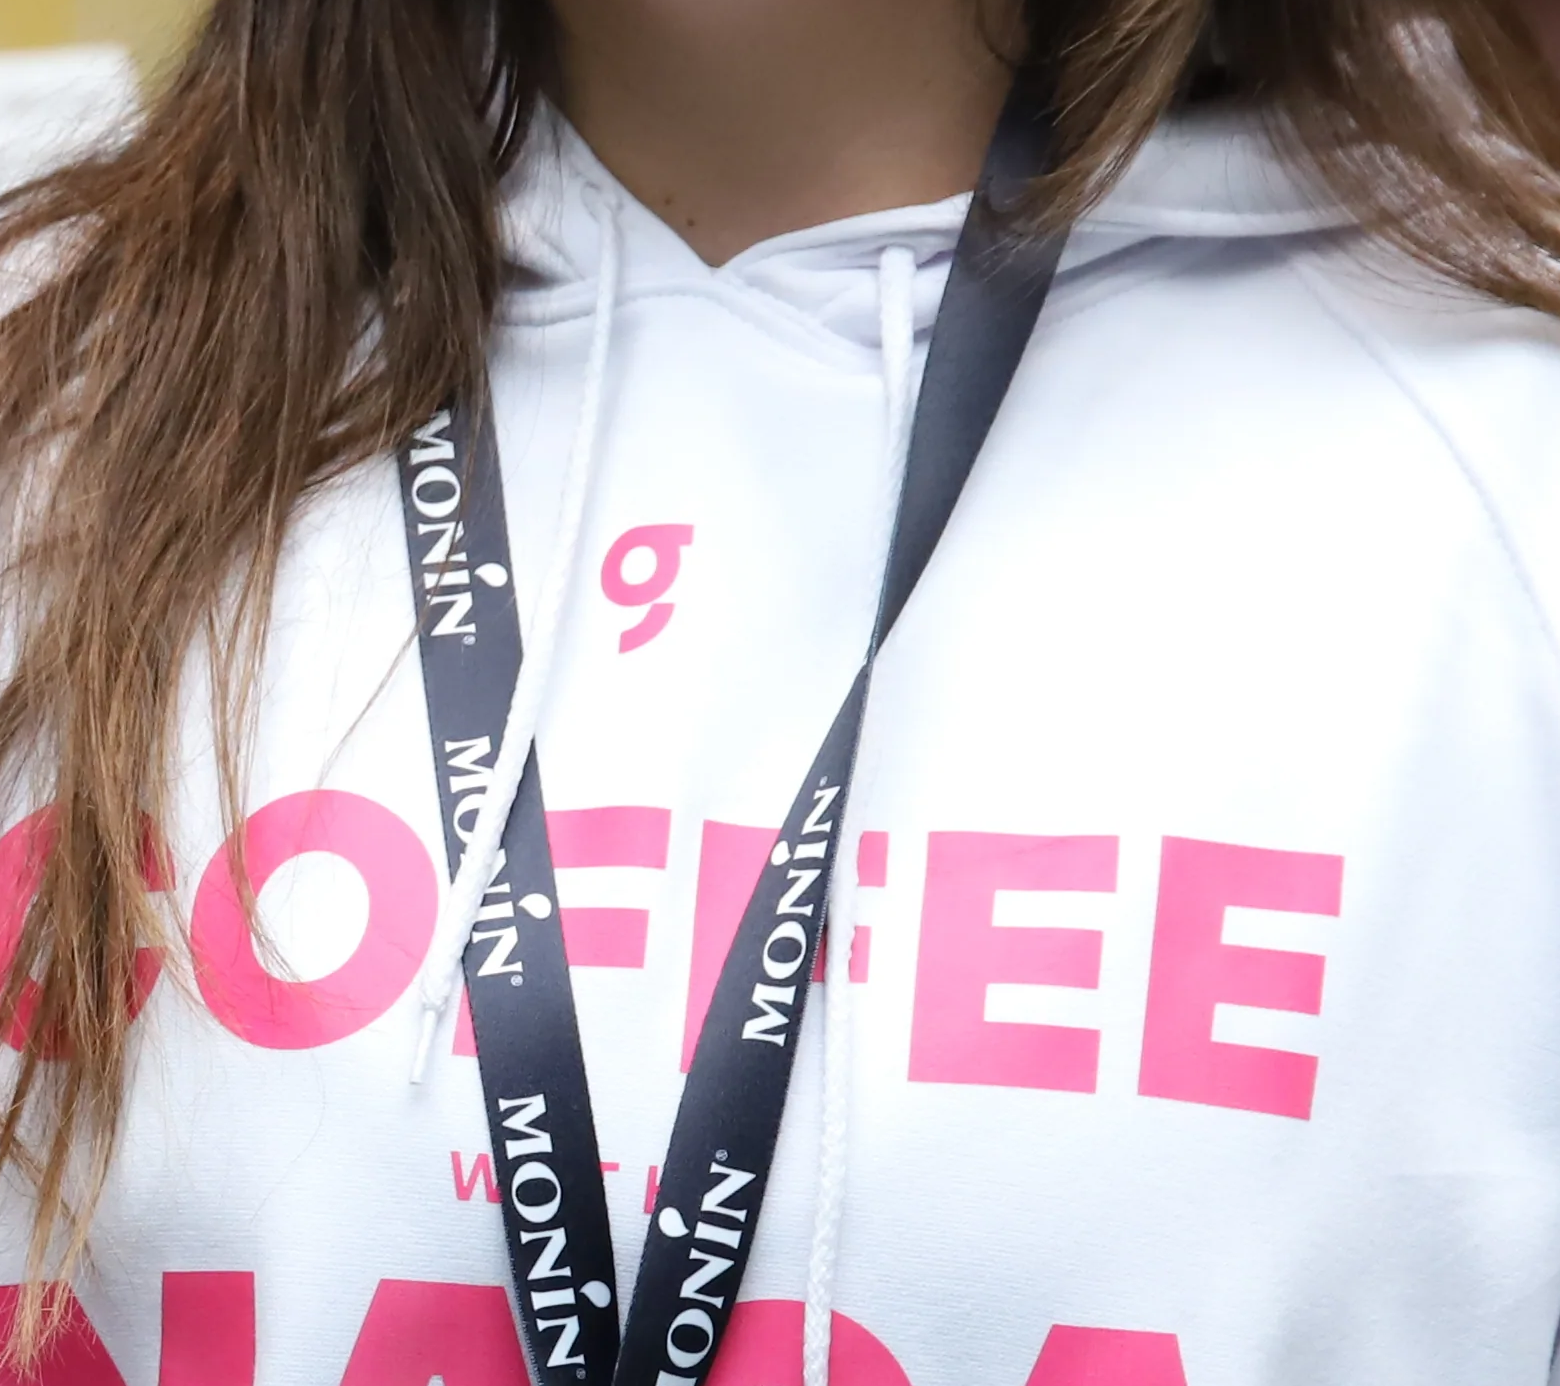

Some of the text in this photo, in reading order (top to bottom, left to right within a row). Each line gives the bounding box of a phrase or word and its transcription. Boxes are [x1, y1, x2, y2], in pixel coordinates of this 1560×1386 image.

[410, 408, 509, 636] MONIN
[741, 782, 841, 1045] MONIN
[498, 1093, 612, 1370] MONIN
